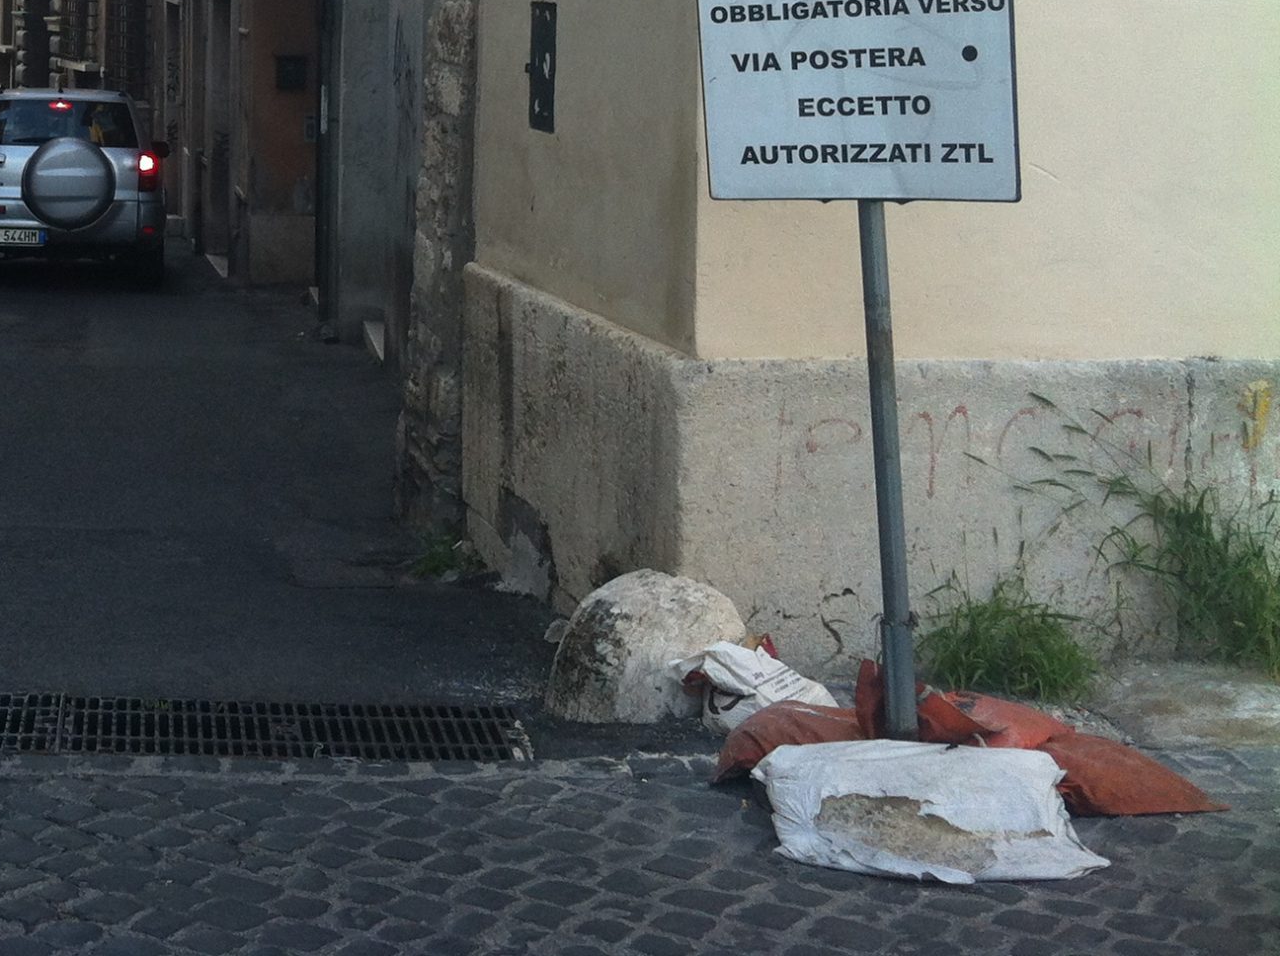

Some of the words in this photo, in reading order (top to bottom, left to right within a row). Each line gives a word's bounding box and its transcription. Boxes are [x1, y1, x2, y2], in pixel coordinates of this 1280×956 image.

[731, 52, 782, 72] VIA
[791, 47, 926, 70] POSTERA
[798, 95, 932, 117] ECCETTO
[740, 143, 932, 165] AUTORIZZATI
[941, 143, 994, 164] ZTL
[3, 230, 38, 242] 544HM
